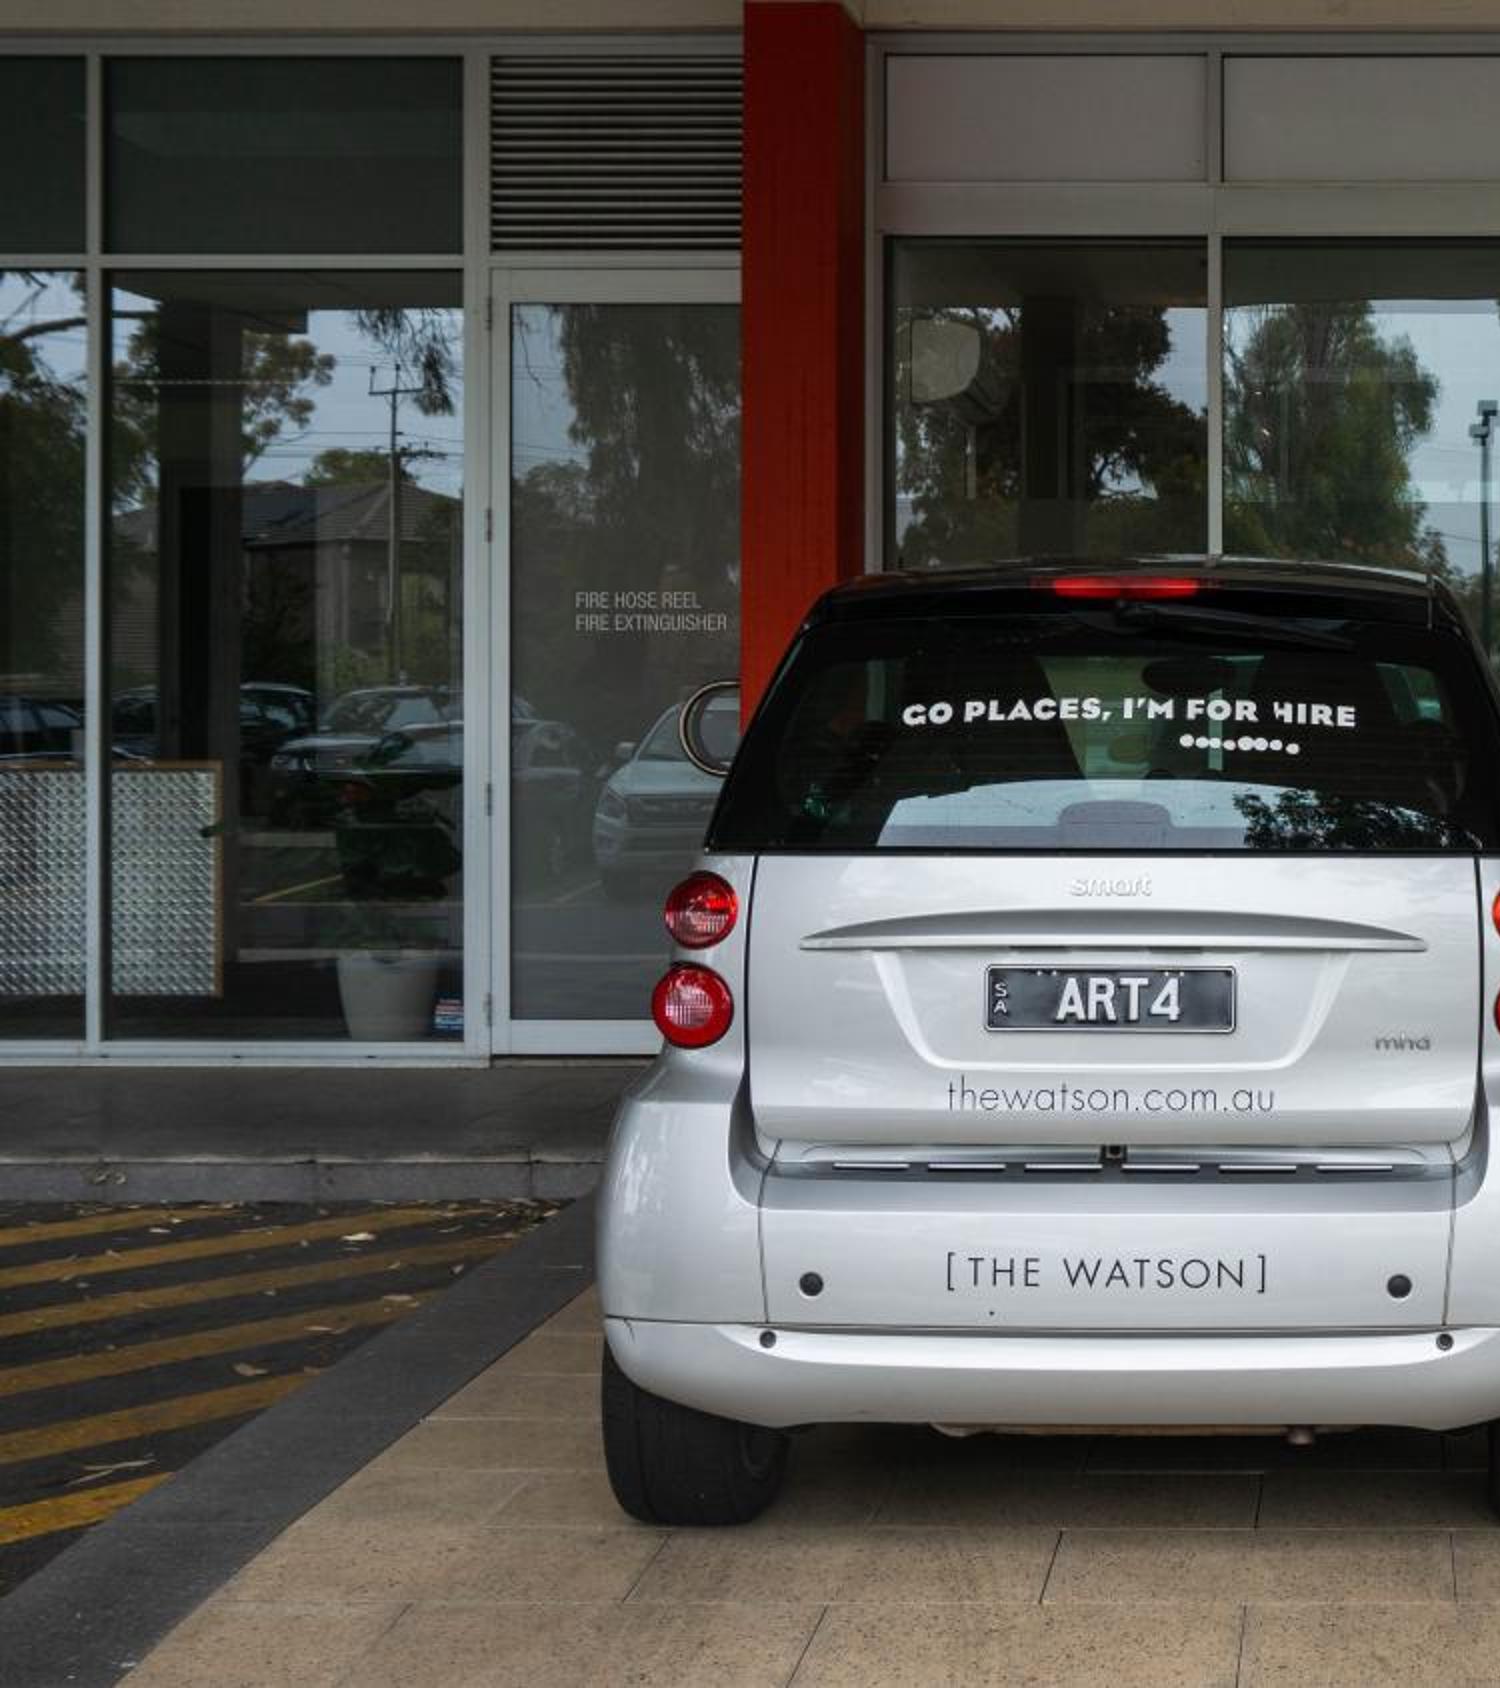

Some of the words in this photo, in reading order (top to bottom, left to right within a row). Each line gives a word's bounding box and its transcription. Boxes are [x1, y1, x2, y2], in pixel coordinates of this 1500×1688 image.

[575, 591, 609, 609] FIRE
[614, 591, 657, 609] HOSE
[662, 591, 701, 609] REEL
[575, 614, 609, 631] FIRE
[615, 614, 727, 631] EXTINGUISHER
[902, 702, 953, 726] GO
[963, 698, 1112, 722] PLACES,
[1123, 698, 1174, 719] I'M
[1187, 699, 1259, 722] FOR
[1273, 702, 1356, 727] HIRE
[1056, 977, 1181, 1021] ART4
[948, 1075, 1274, 1111] thewatson.com.au
